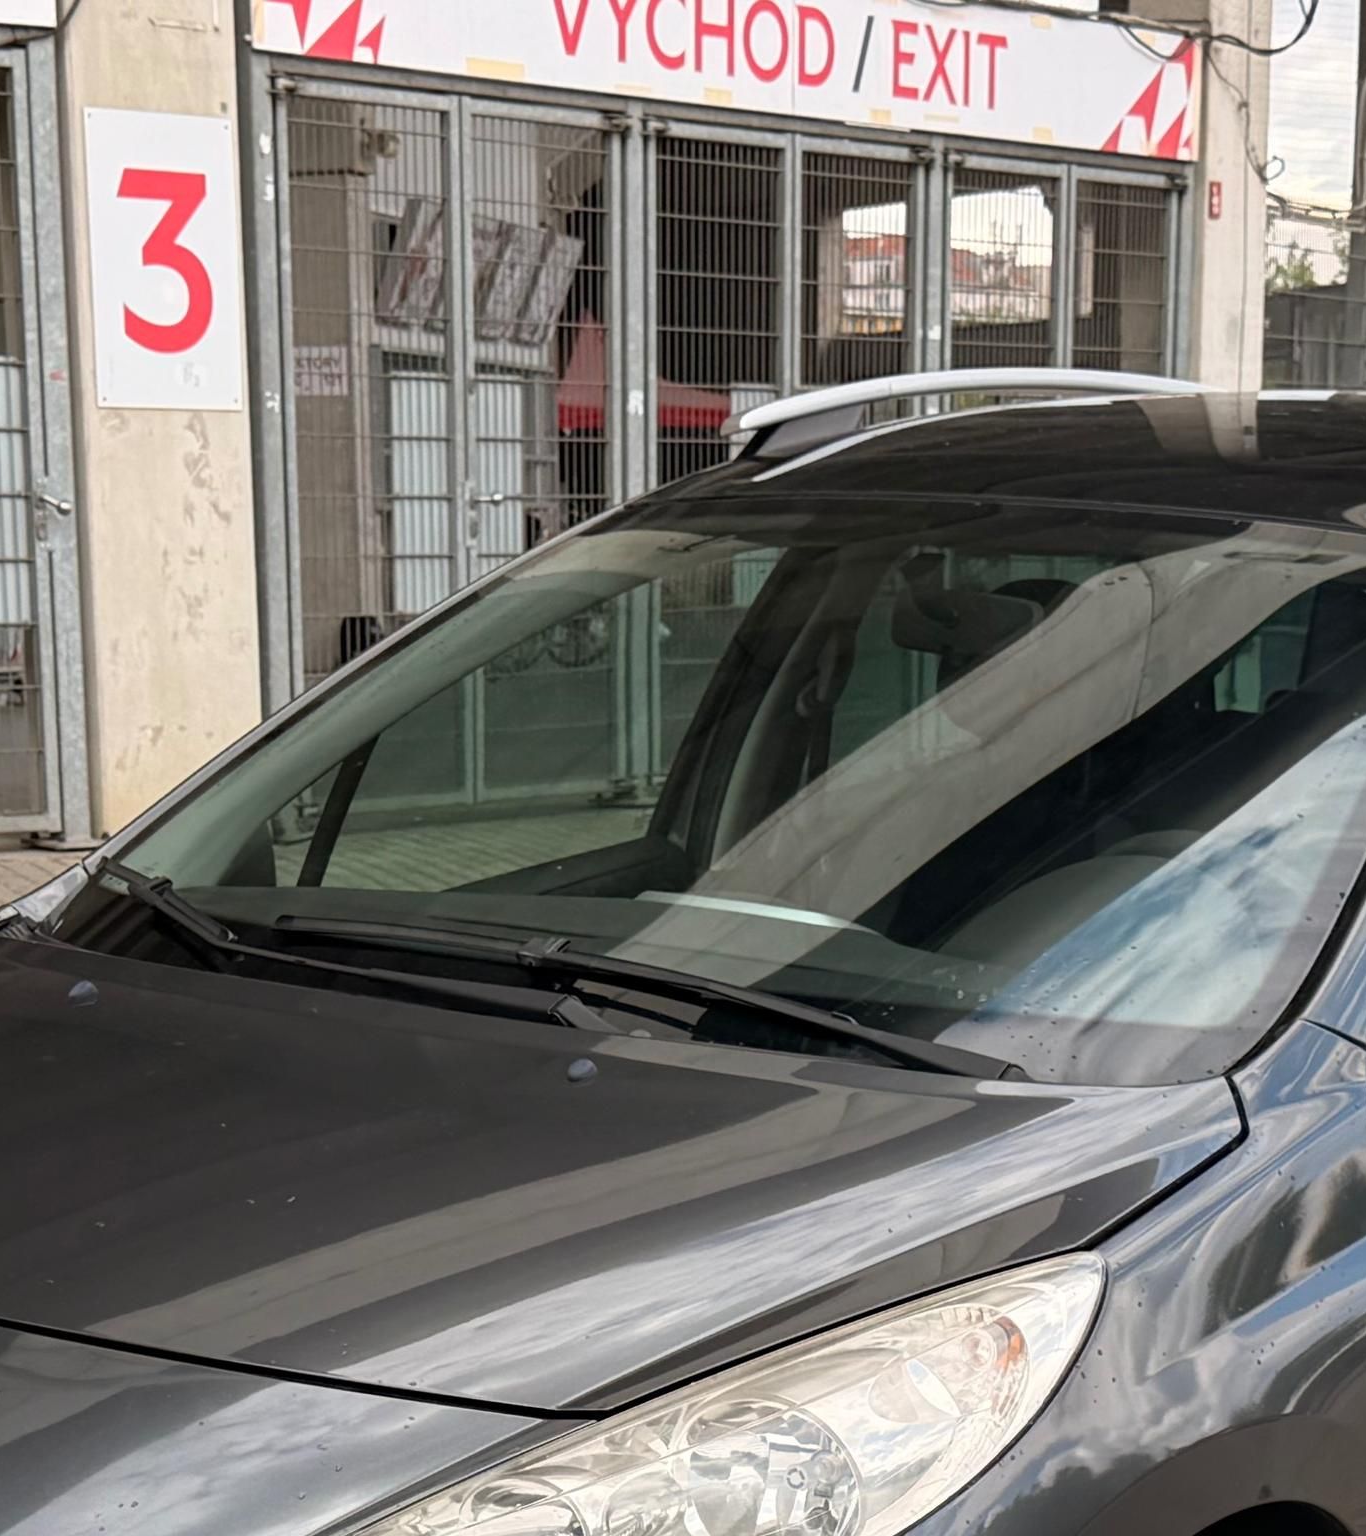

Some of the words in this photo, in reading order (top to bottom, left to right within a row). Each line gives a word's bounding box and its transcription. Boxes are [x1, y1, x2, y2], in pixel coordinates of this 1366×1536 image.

[553, 0, 835, 86] VYCHOD
[891, 20, 1009, 109] EXIT
[116, 167, 214, 354] 3
